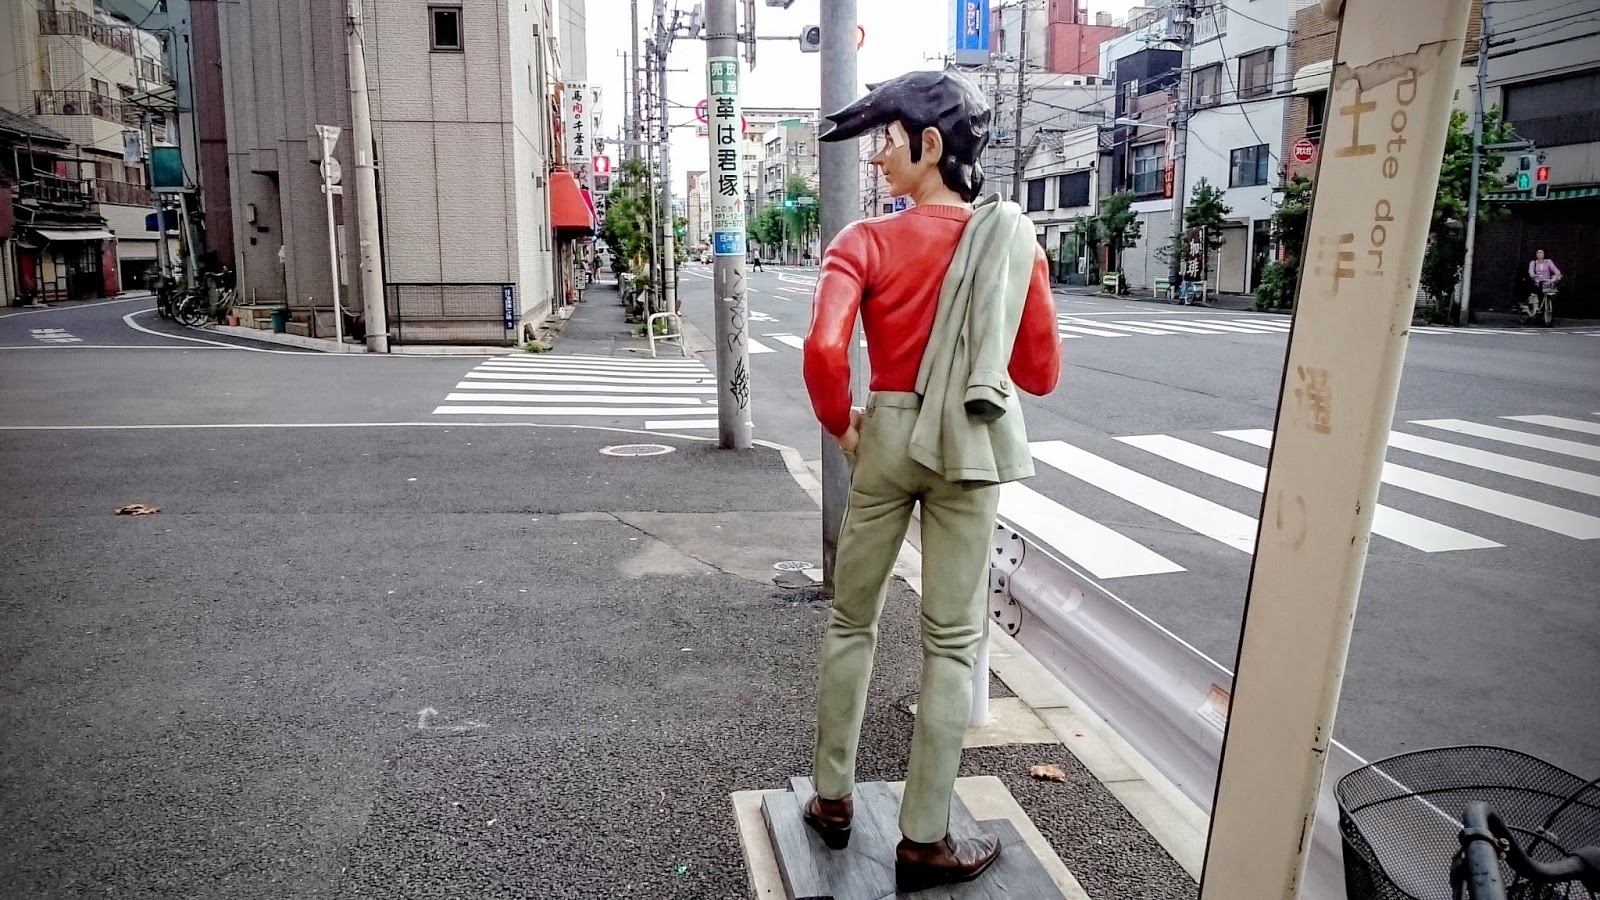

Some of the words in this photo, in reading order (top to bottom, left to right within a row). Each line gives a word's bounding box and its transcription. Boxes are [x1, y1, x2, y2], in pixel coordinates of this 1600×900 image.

[966, 2, 975, 36] ひがしん
[571, 90, 585, 156] 馬肉の千葉屋
[715, 96, 739, 197] 革は君塚
[1367, 199, 1394, 277] dori
